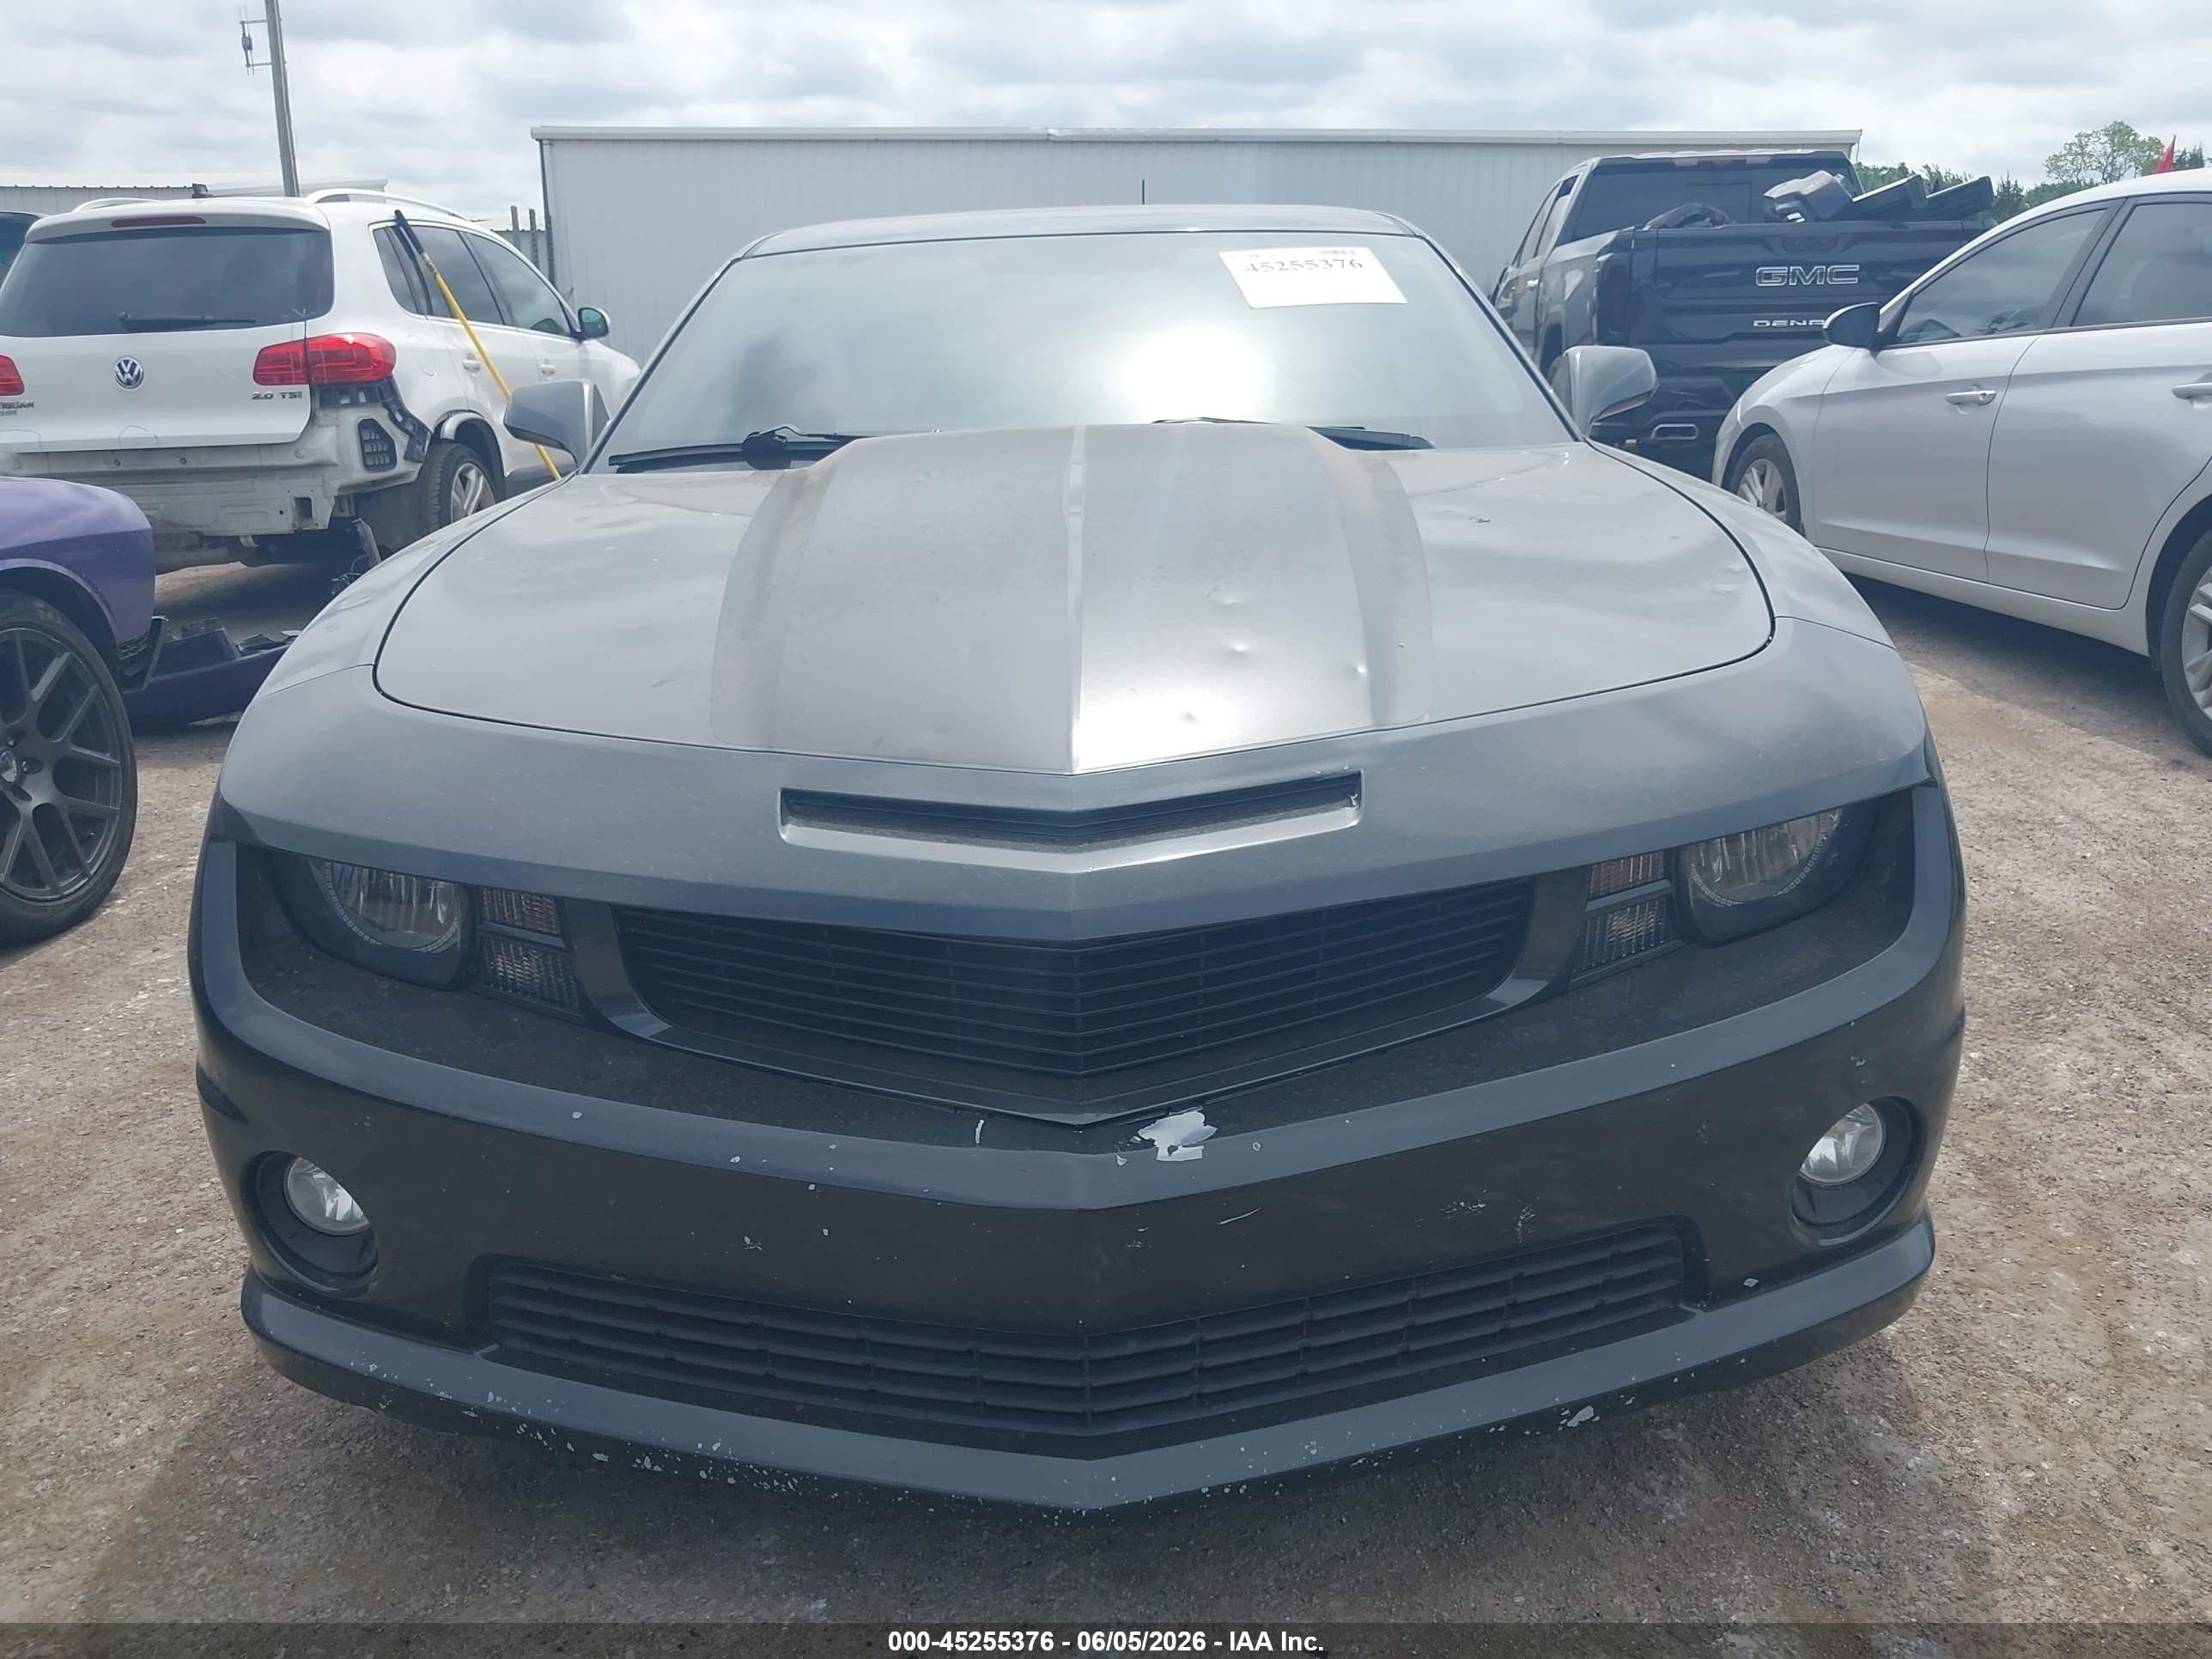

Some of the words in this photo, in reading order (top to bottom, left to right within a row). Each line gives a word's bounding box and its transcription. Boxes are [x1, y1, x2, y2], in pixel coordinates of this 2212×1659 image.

[1245, 258, 1364, 273] 45255376
[1755, 264, 1860, 287] GMC
[1753, 319, 1825, 327] DENA
